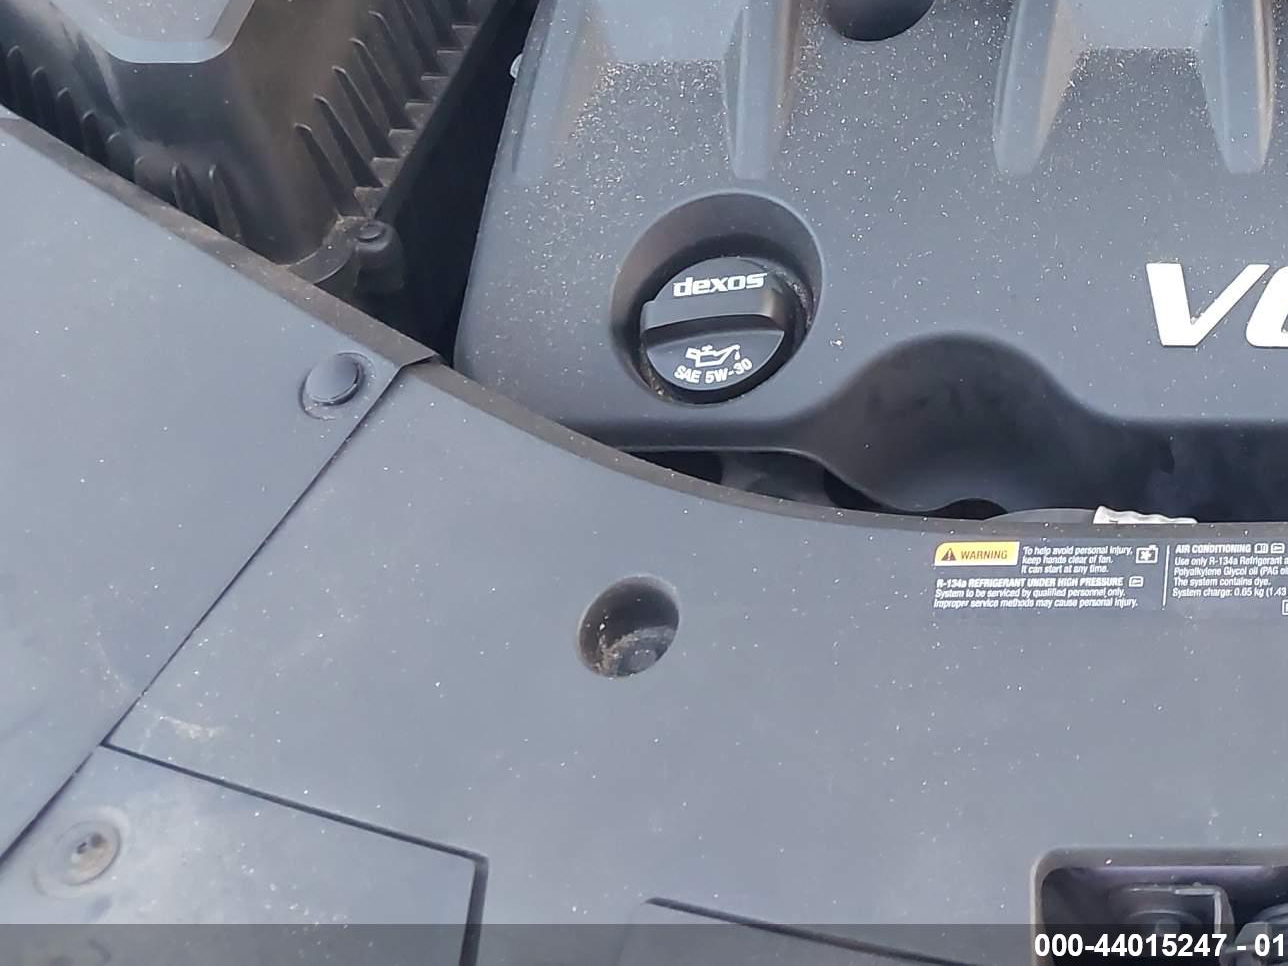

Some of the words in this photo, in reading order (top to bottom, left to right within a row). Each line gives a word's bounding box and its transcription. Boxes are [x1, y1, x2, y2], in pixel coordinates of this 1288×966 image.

[672, 272, 767, 297] dexos
[673, 365, 702, 383] SAE
[705, 357, 753, 383] 5W-30
[1023, 546, 1033, 555] To
[1034, 546, 1051, 556] help
[1052, 546, 1073, 555] avoid
[1075, 546, 1108, 556] personal
[1175, 544, 1190, 554] AIR
[1192, 544, 1251, 553] CONDITIONING
[960, 550, 1008, 560] WARNING
[1022, 556, 1041, 565] keep
[1043, 555, 1066, 564] hands
[1068, 555, 1088, 564] clear
[1089, 555, 1096, 564] of
[1097, 555, 1113, 564] fan.
[1174, 557, 1190, 565] Use
[1191, 556, 1207, 567] only
[1209, 556, 1238, 565] R-134a
[1240, 556, 1282, 567] Refrigerant
[1044, 565, 1062, 574] start
[1063, 565, 1072, 574] at
[1073, 566, 1088, 575] any
[1089, 565, 1109, 574] time.
[936, 579, 967, 588] R-134a
[968, 578, 1026, 587] REFRIGERANT
[1027, 578, 1056, 587] UNDER
[1057, 577, 1079, 587] HIGH
[1080, 577, 1124, 586] PRESSURE
[1174, 577, 1189, 586] The
[1190, 578, 1218, 587] system
[1220, 577, 1252, 586] contains
[1254, 577, 1271, 587] dye.
[935, 589, 964, 599] System
[966, 589, 974, 598] to
[975, 589, 986, 598] be
[987, 589, 1020, 597] serviced
[1022, 589, 1031, 598] by
[1032, 588, 1067, 598] qualified
[1068, 588, 1106, 598] personnel
[1107, 588, 1126, 598] only.
[934, 599, 969, 609] Improper
[970, 599, 998, 608] service
[1000, 599, 1034, 607] methods
[1036, 599, 1052, 609] may
[1054, 599, 1077, 607] cause
[1079, 599, 1113, 608] personal
[1114, 598, 1138, 608] injury.
